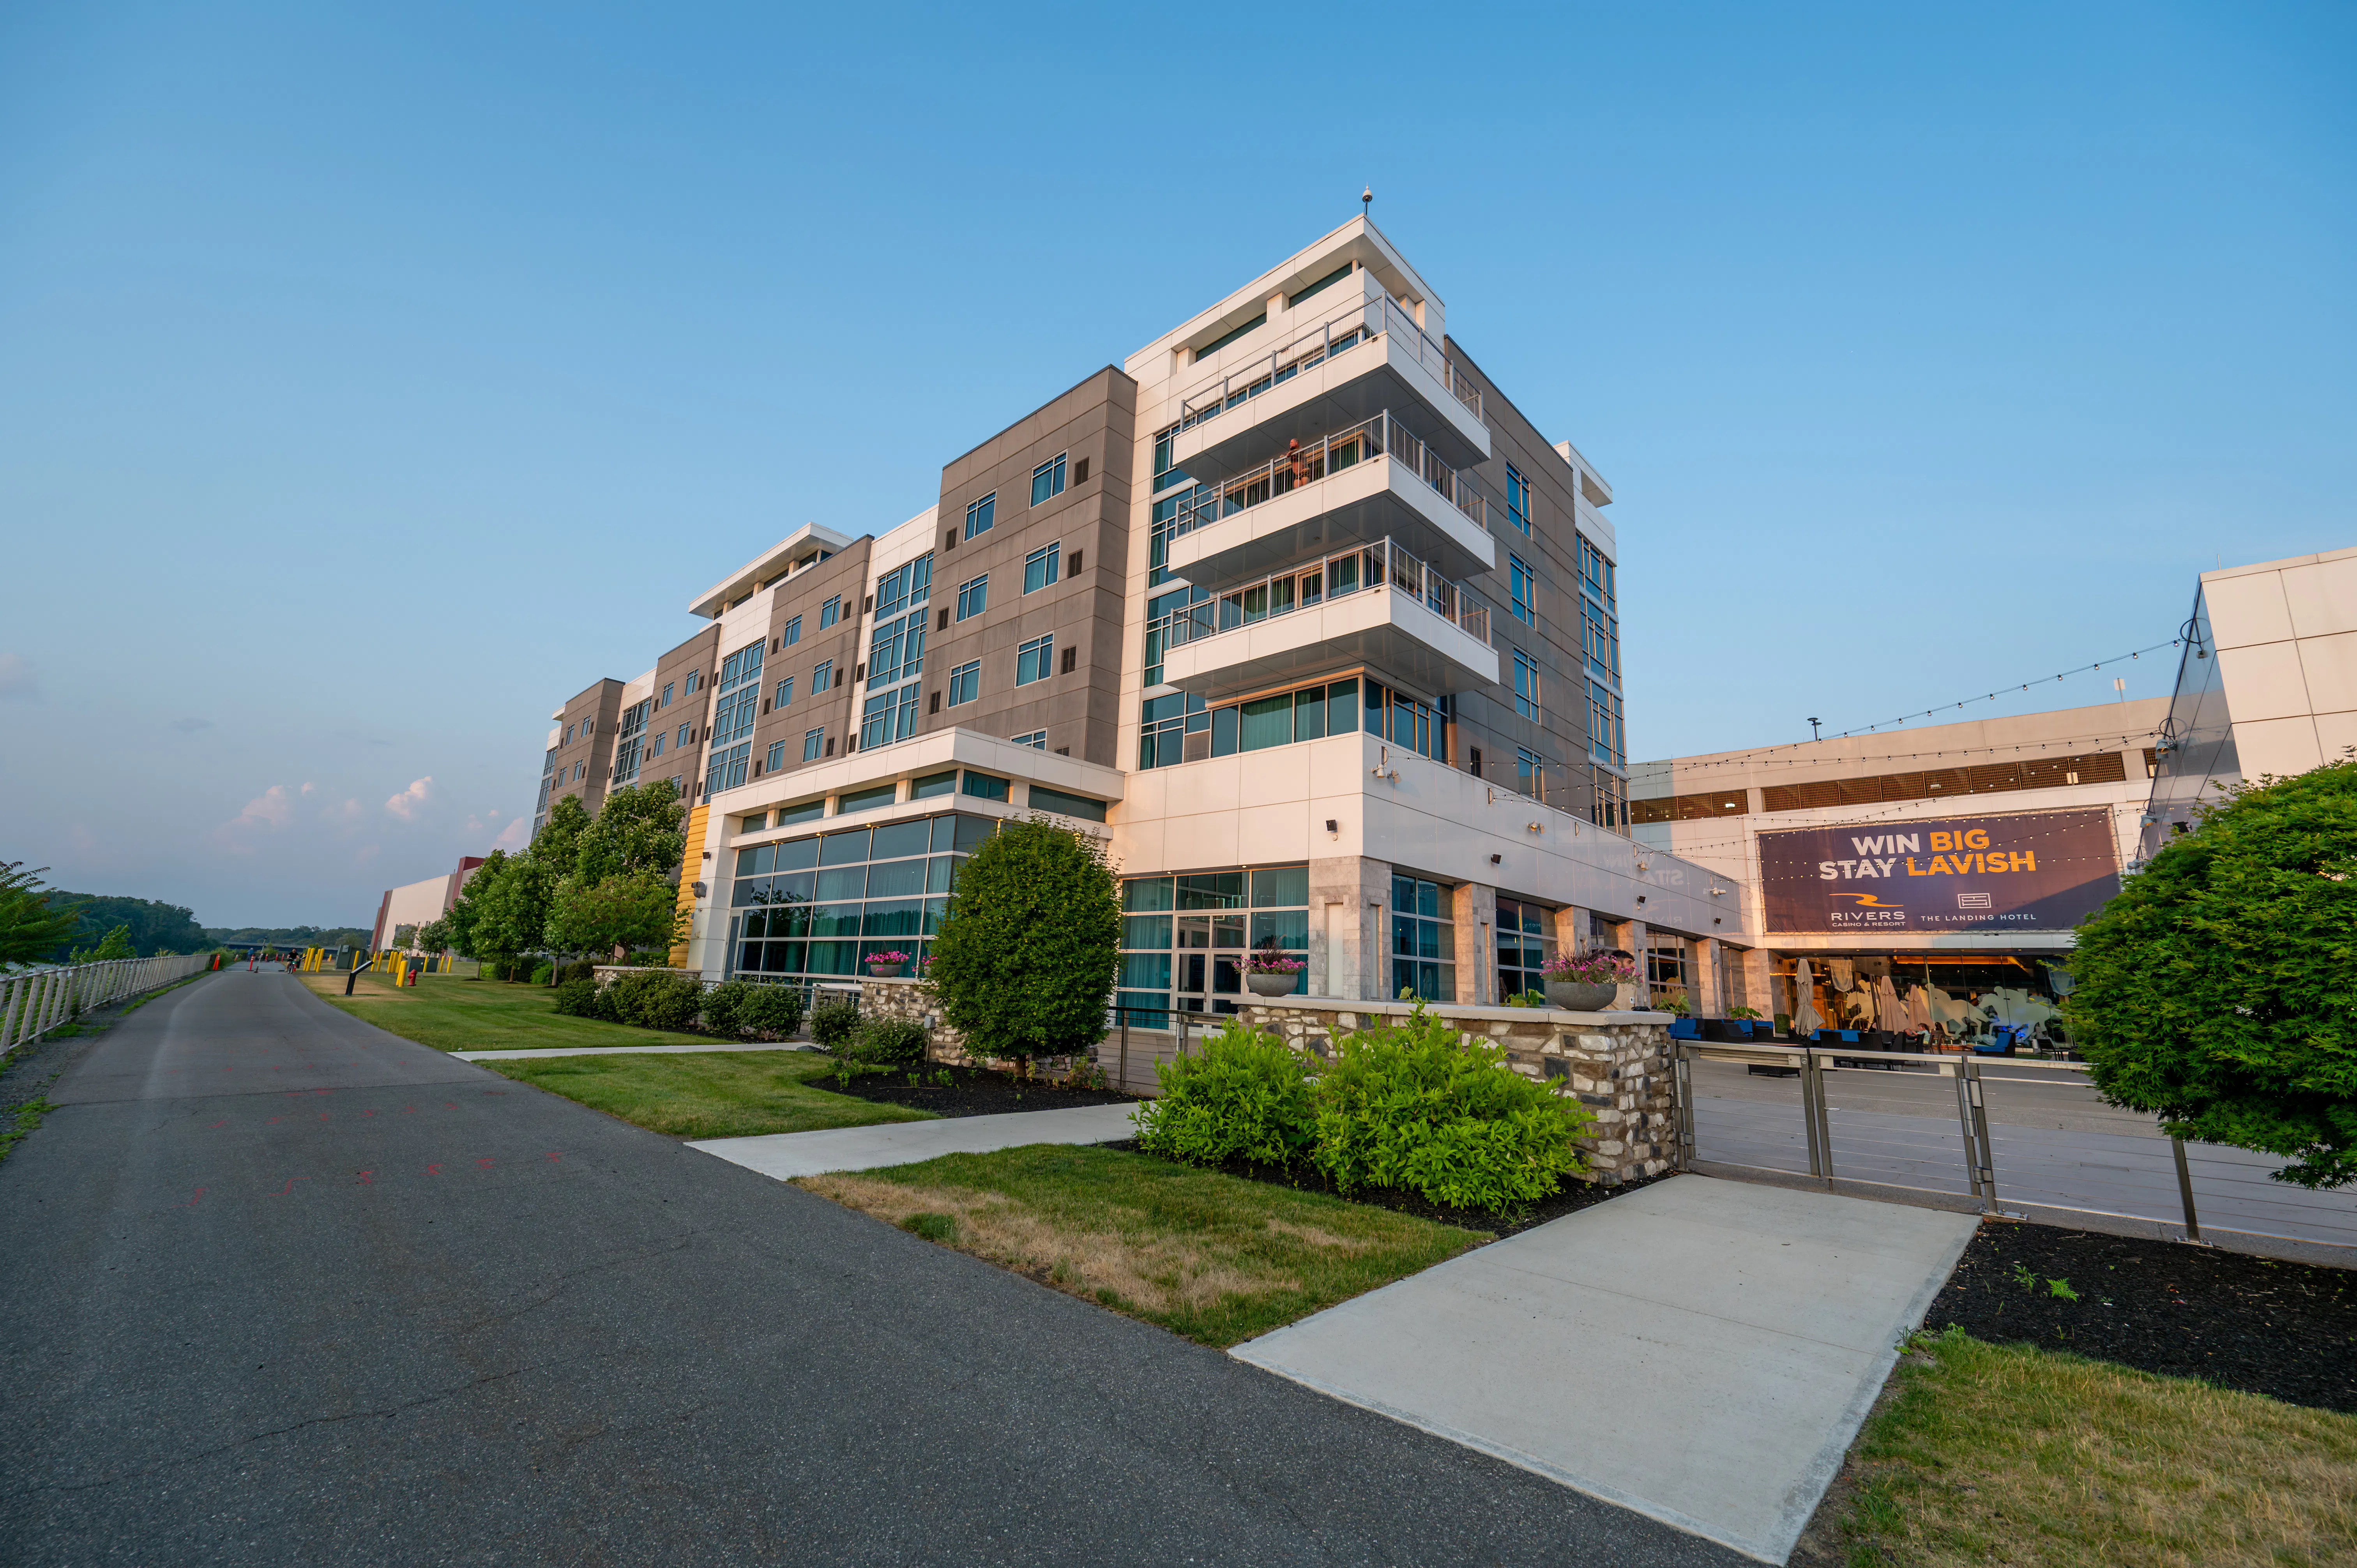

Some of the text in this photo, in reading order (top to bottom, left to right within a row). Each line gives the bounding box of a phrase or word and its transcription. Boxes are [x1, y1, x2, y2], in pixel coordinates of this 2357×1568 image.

[1851, 829, 1990, 856] WIN BIG
[1820, 851, 2036, 880] STAY LAVISH
[1831, 911, 1905, 921] RIVERS
